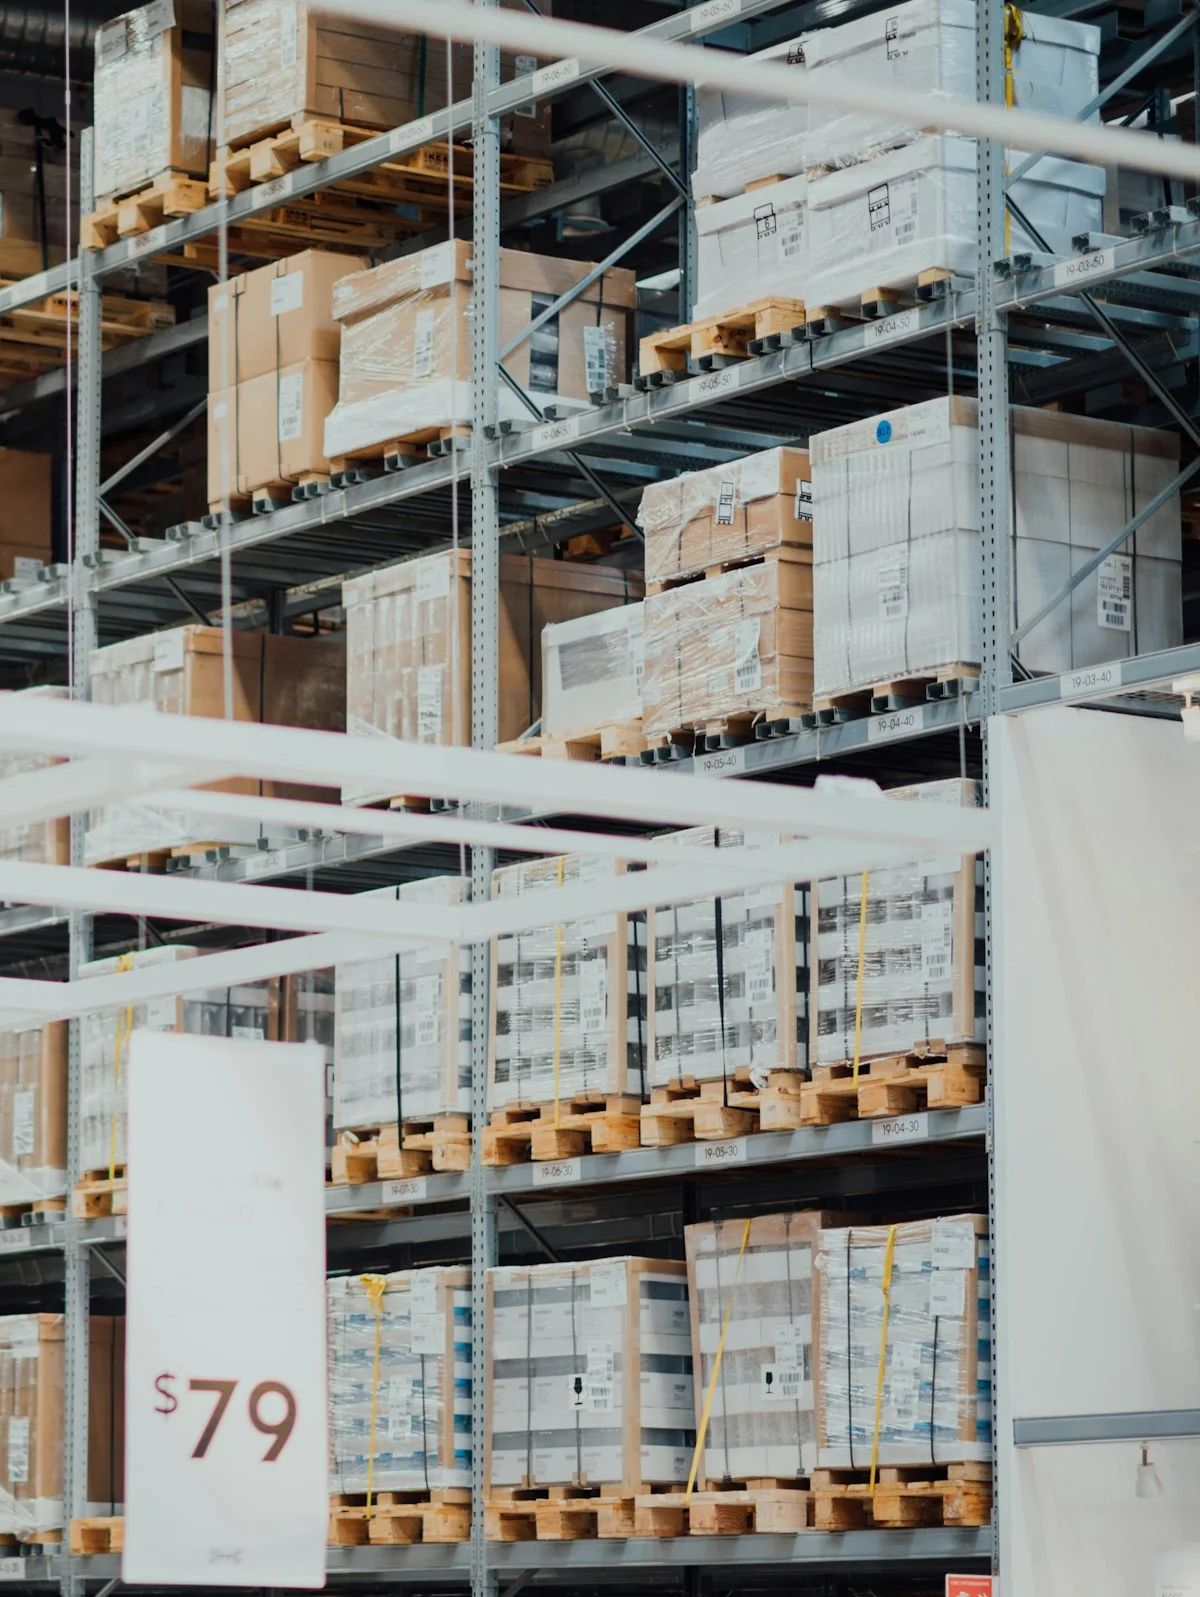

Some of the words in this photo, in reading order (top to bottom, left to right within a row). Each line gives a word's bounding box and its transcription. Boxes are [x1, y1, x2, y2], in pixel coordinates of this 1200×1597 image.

[1066, 254, 1105, 277] 19-03-50
[874, 316, 911, 337] 19-04-50
[1072, 670, 1112, 689] 19-03-40
[878, 714, 915, 733] 19-04-40
[703, 755, 737, 772] 19-05-40
[882, 1120, 920, 1136] 19-04-30
[704, 1145, 738, 1159] 19-05-30
[541, 1164, 573, 1179] 19-06-30
[154, 1372, 297, 1463] $79
